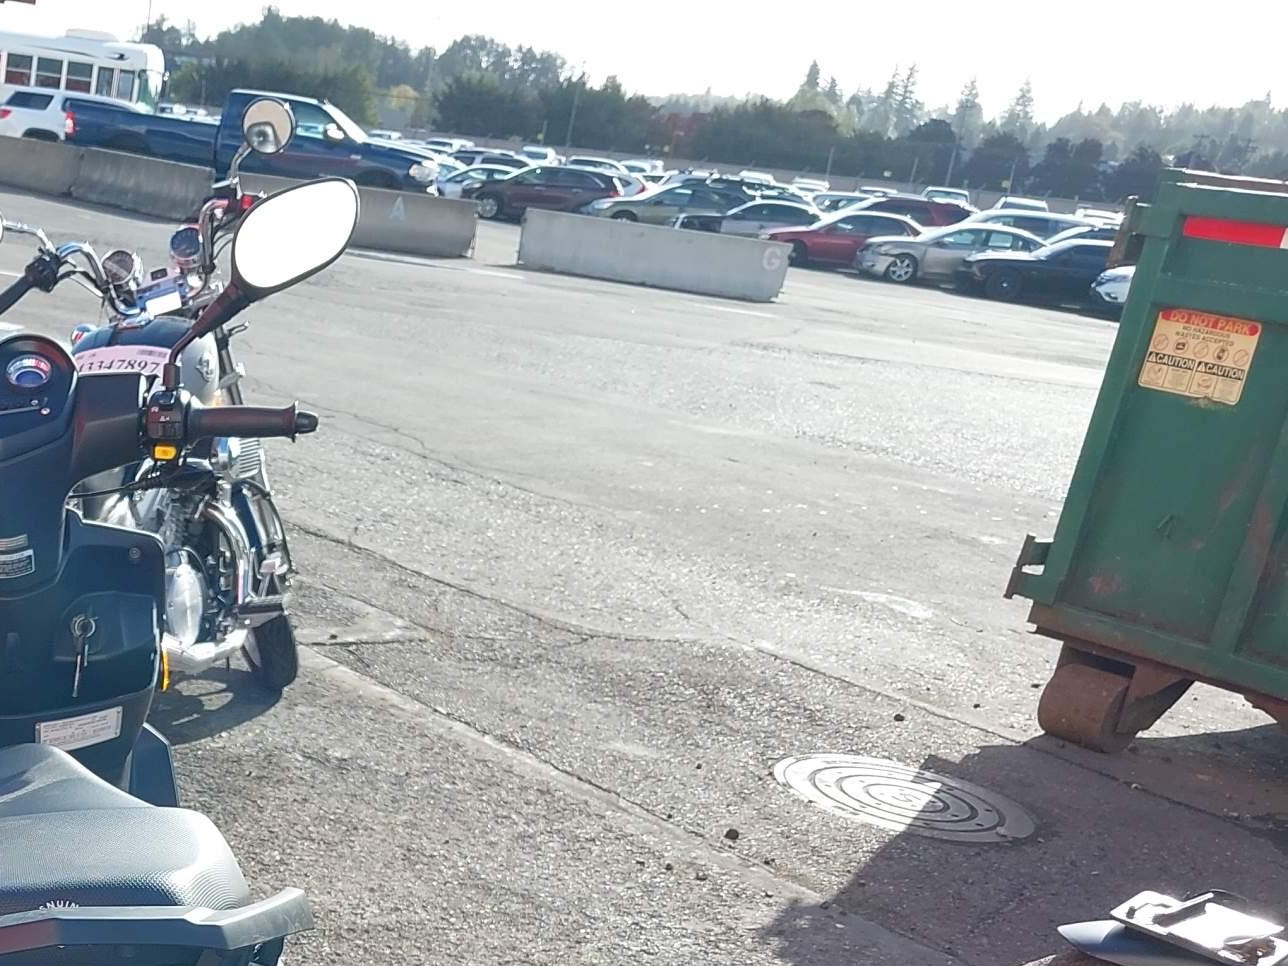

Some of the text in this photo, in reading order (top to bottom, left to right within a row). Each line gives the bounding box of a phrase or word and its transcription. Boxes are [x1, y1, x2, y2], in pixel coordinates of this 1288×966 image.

[1170, 311, 1252, 335] DO NOT PARK
[1157, 354, 1196, 369] CAUTION
[1206, 363, 1244, 380] CAUTION
